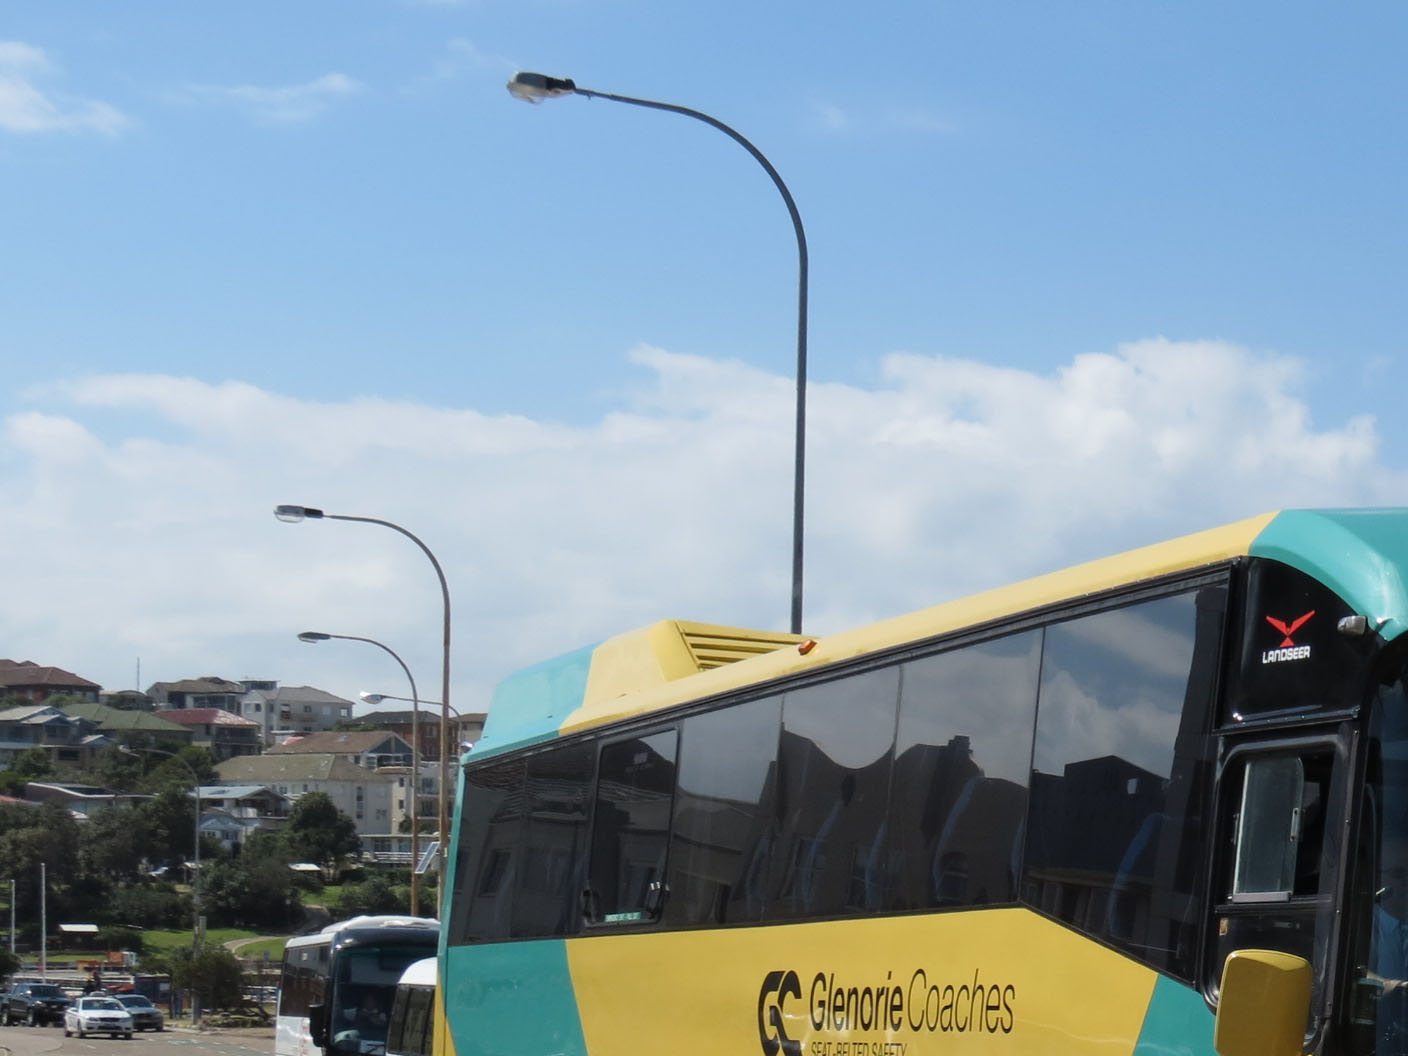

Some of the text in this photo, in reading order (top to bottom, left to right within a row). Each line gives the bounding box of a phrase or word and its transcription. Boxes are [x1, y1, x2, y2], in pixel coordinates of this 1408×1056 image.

[1262, 646, 1311, 664] LANDSEER
[809, 968, 1015, 1034] Glenorie Coaches
